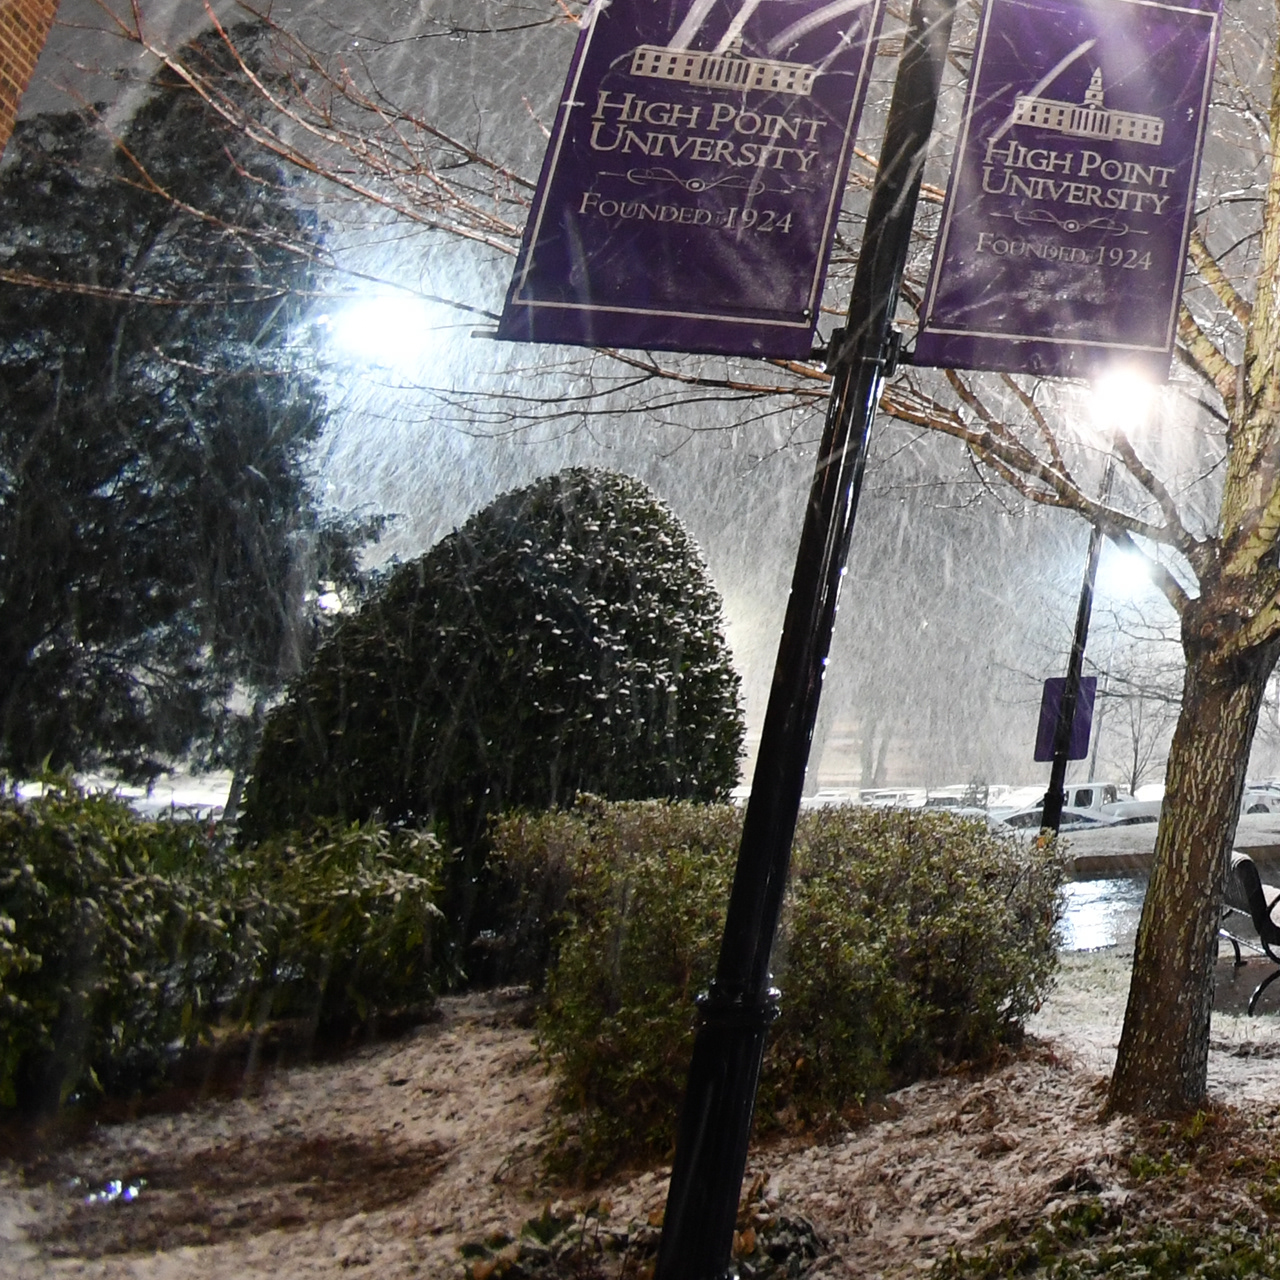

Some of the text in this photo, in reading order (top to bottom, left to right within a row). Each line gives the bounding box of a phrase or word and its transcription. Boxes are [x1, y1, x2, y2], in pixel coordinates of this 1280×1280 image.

[591, 90, 828, 143] HIGH POINT
[590, 121, 819, 172] UNIVERSITY
[982, 137, 1175, 188] HIGH POINT
[578, 192, 712, 225] FOUNDED
[725, 207, 794, 234] 1924
[982, 166, 1170, 215] UNIVERSITY
[1096, 245, 1152, 270] 1924
